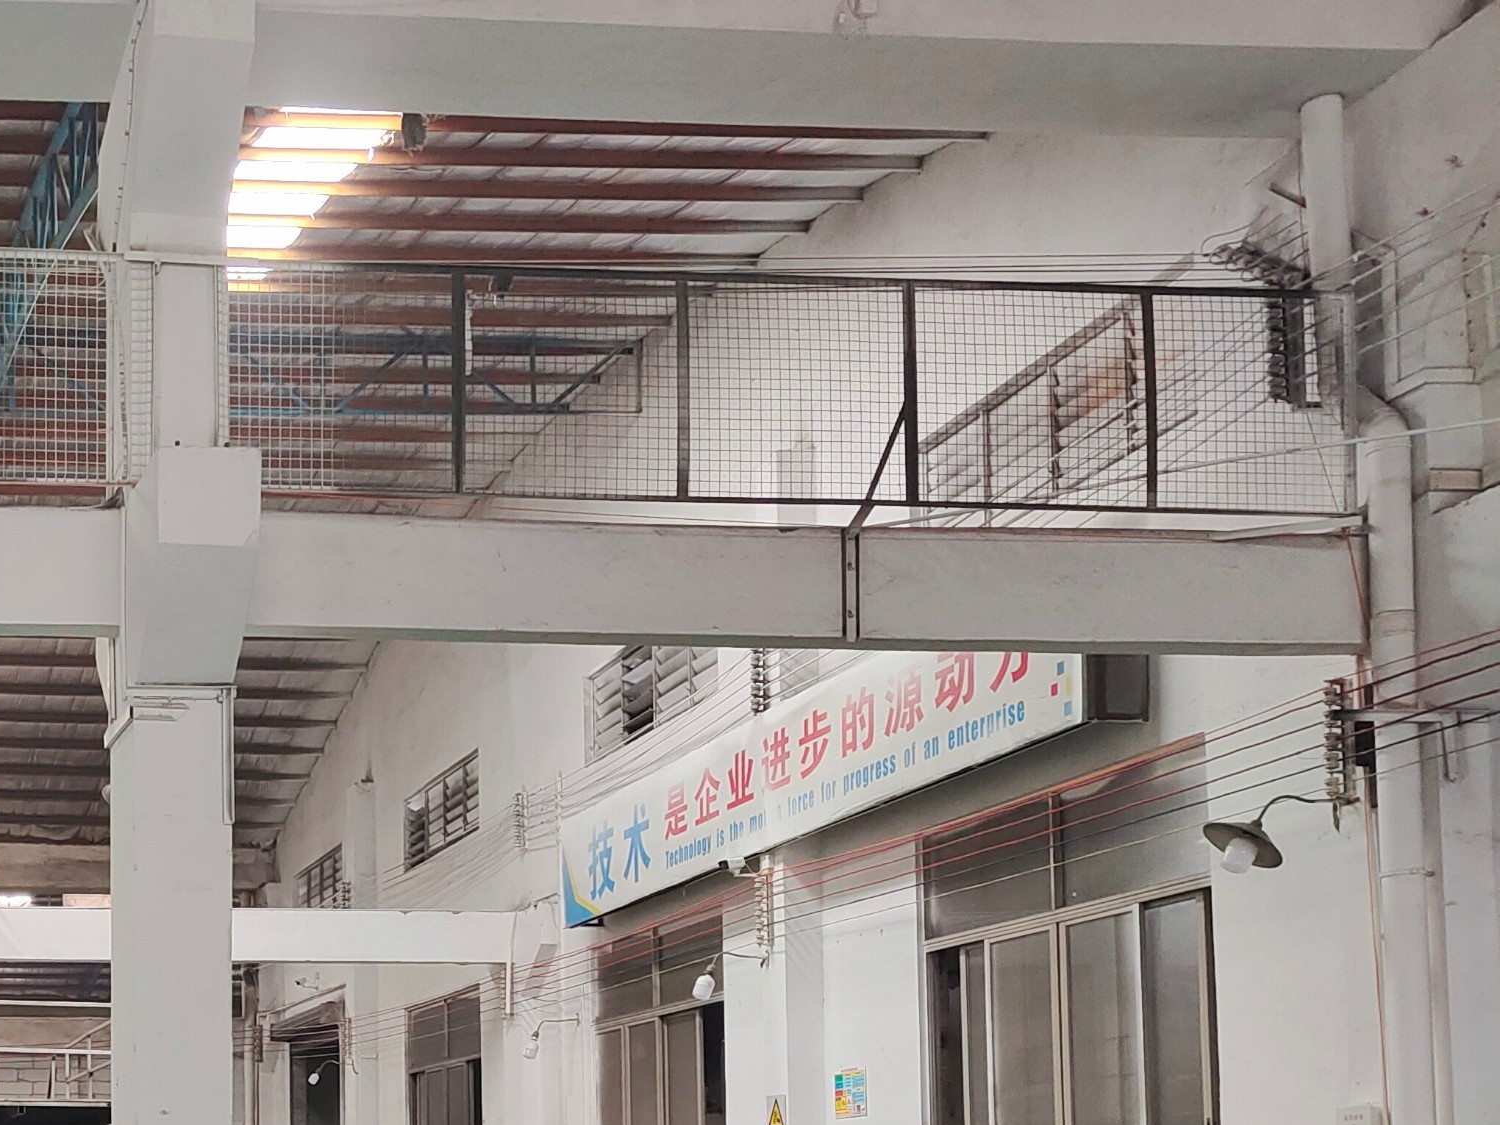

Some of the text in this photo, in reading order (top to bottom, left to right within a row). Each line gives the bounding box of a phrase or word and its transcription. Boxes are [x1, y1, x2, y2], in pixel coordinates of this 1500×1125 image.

[665, 834, 712, 869] Technology
[716, 828, 725, 848] is
[729, 820, 744, 842] the
[788, 789, 815, 817] force
[821, 778, 837, 803] for
[843, 754, 896, 796] progress
[904, 742, 917, 768] of
[924, 735, 939, 760] an
[948, 700, 1025, 750] enterprise
